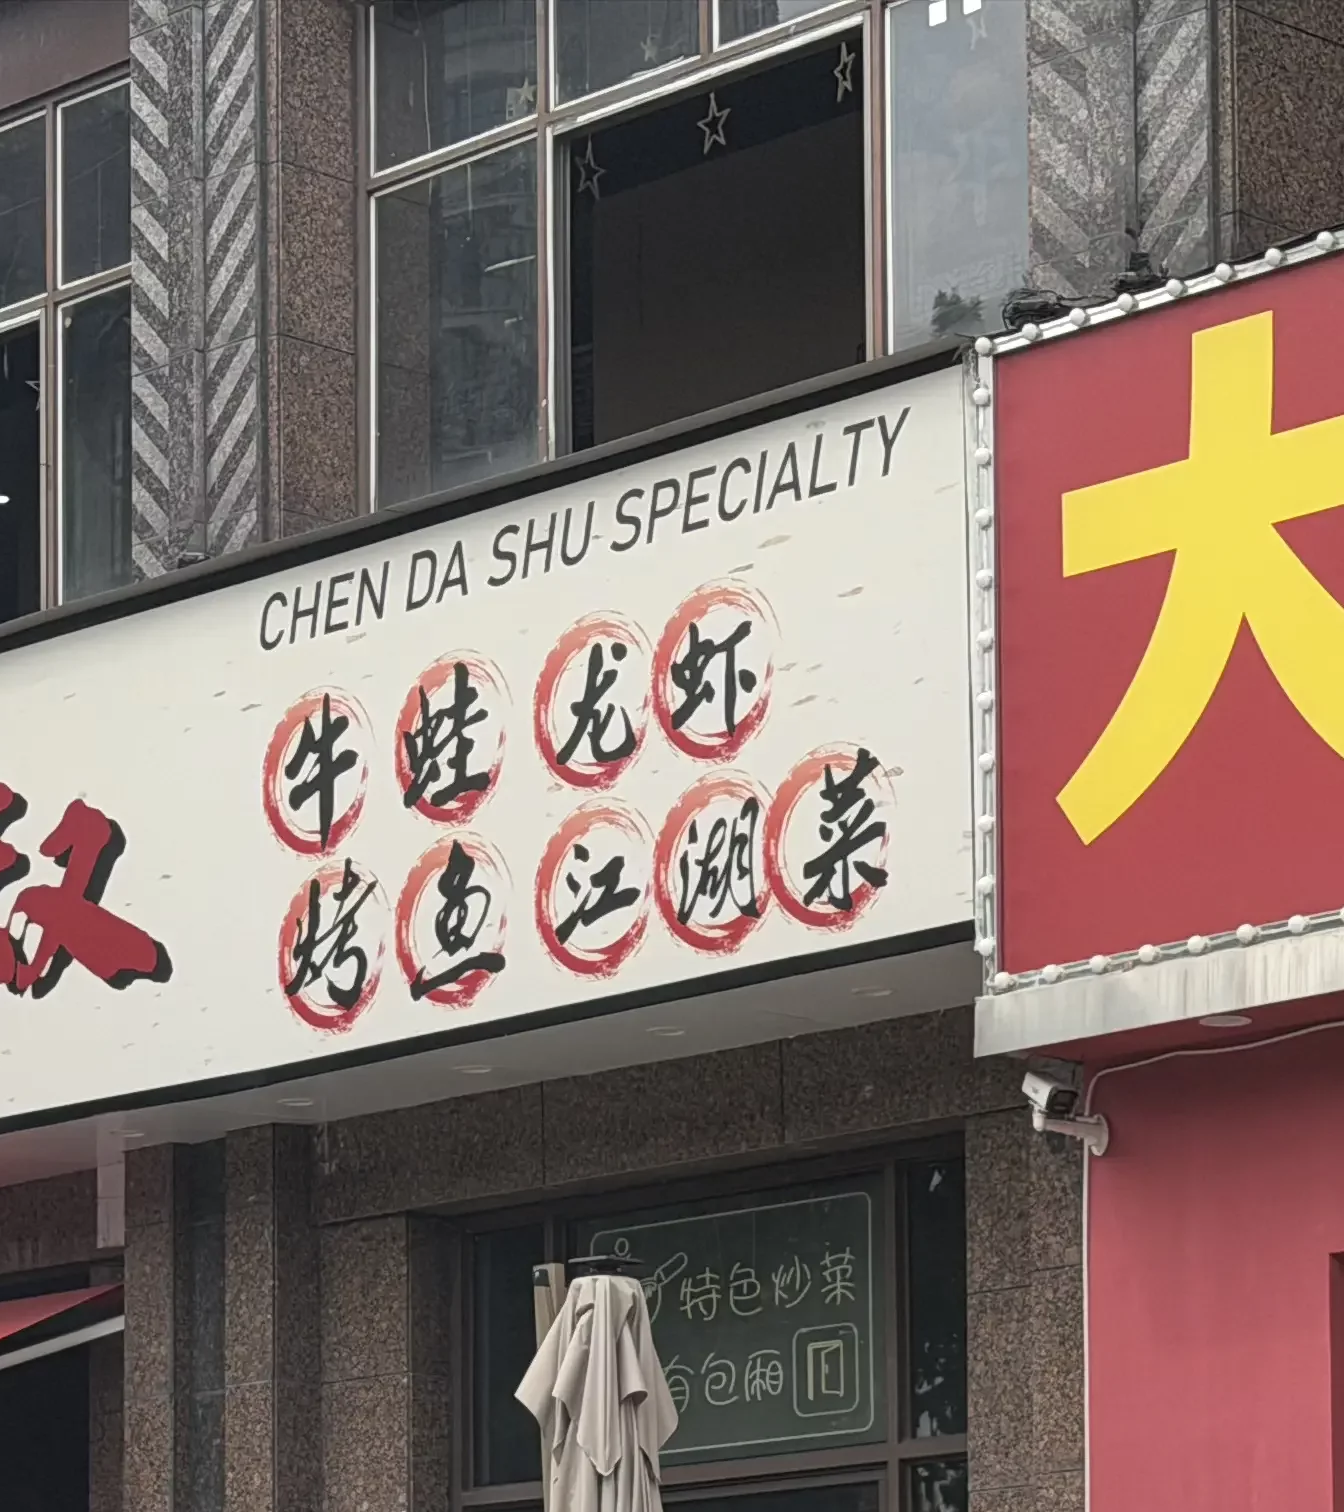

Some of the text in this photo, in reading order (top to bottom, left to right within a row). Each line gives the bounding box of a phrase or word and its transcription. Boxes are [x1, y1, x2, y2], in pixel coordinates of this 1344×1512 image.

[259, 407, 911, 651] CHEN DA SHU SPECIALTY
[284, 620, 757, 852] 牛蛙龙虾
[284, 748, 888, 1010] 烤鱼江湖菜
[680, 1246, 855, 1321] 特色炒菜
